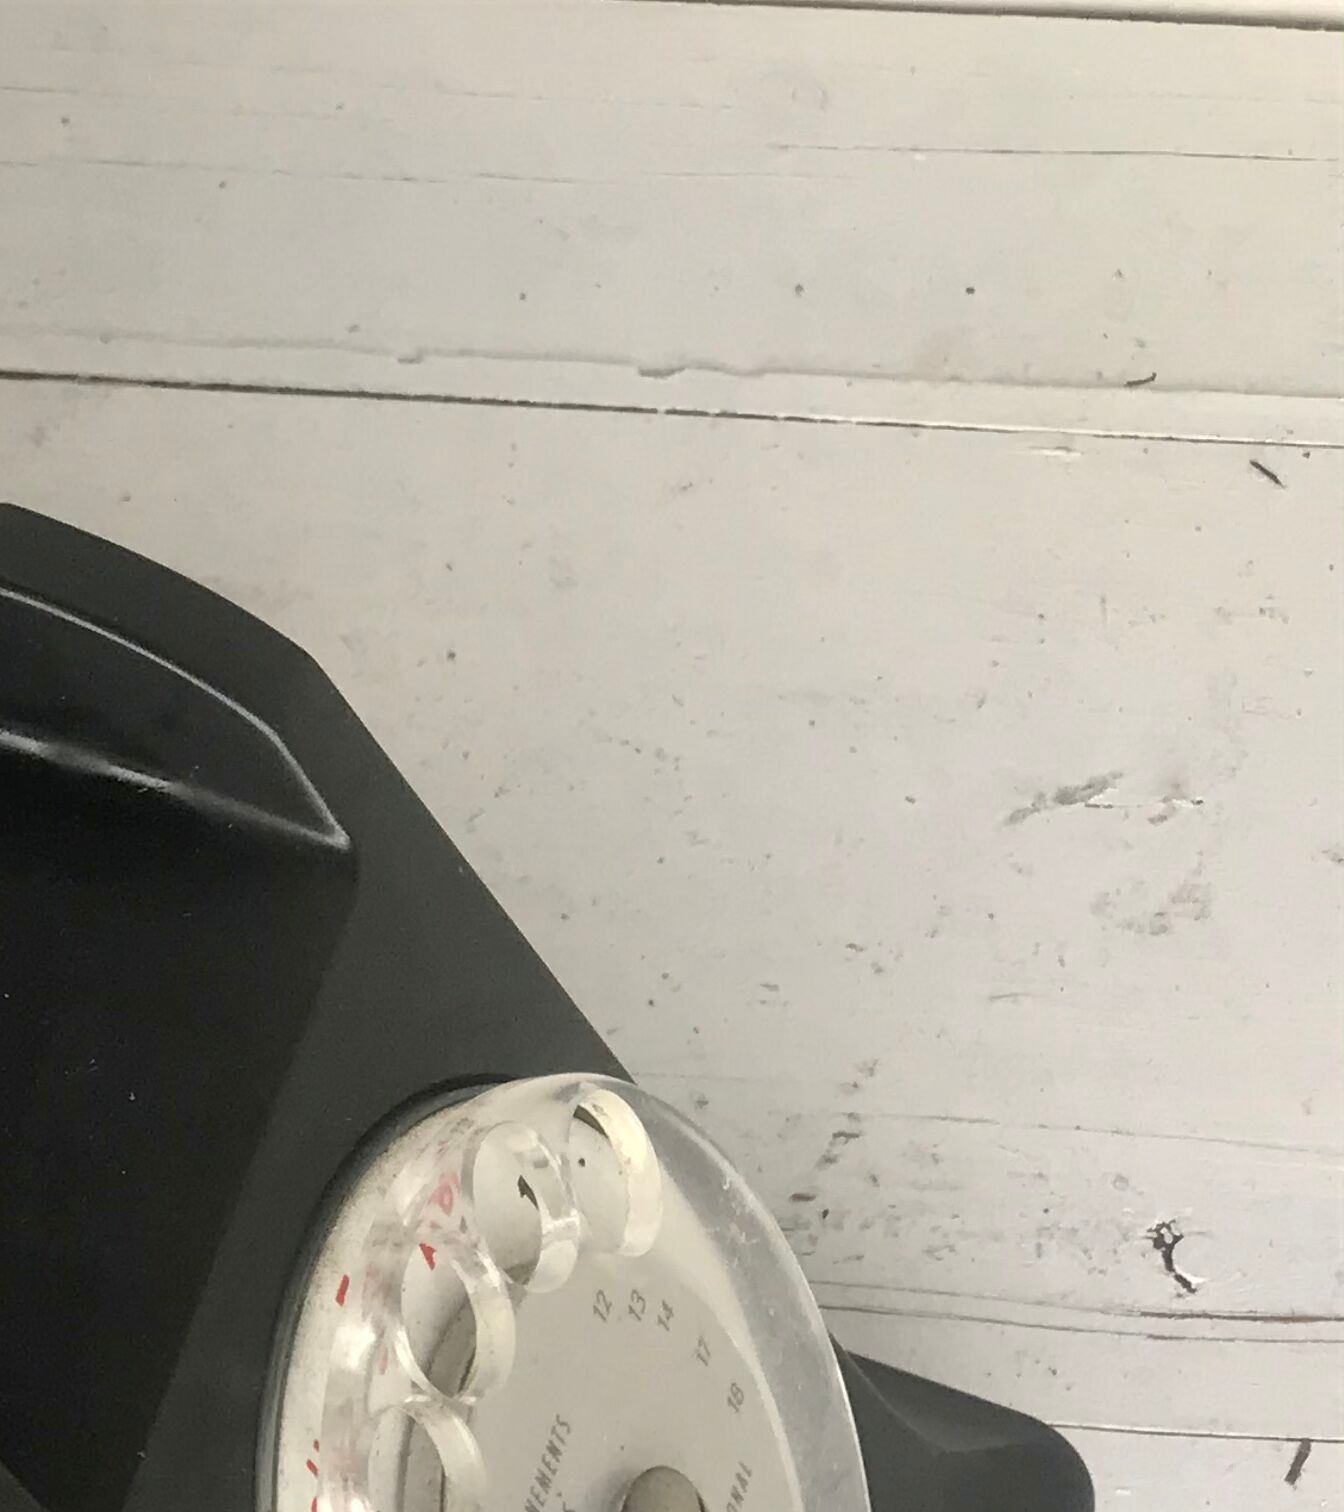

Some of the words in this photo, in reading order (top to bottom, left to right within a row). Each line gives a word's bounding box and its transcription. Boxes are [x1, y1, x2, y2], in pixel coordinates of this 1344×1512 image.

[593, 1288, 612, 1323] 12
[628, 1288, 646, 1322] 13
[657, 1299, 674, 1332] 14
[696, 1336, 711, 1367] 17
[727, 1382, 745, 1413] 18
